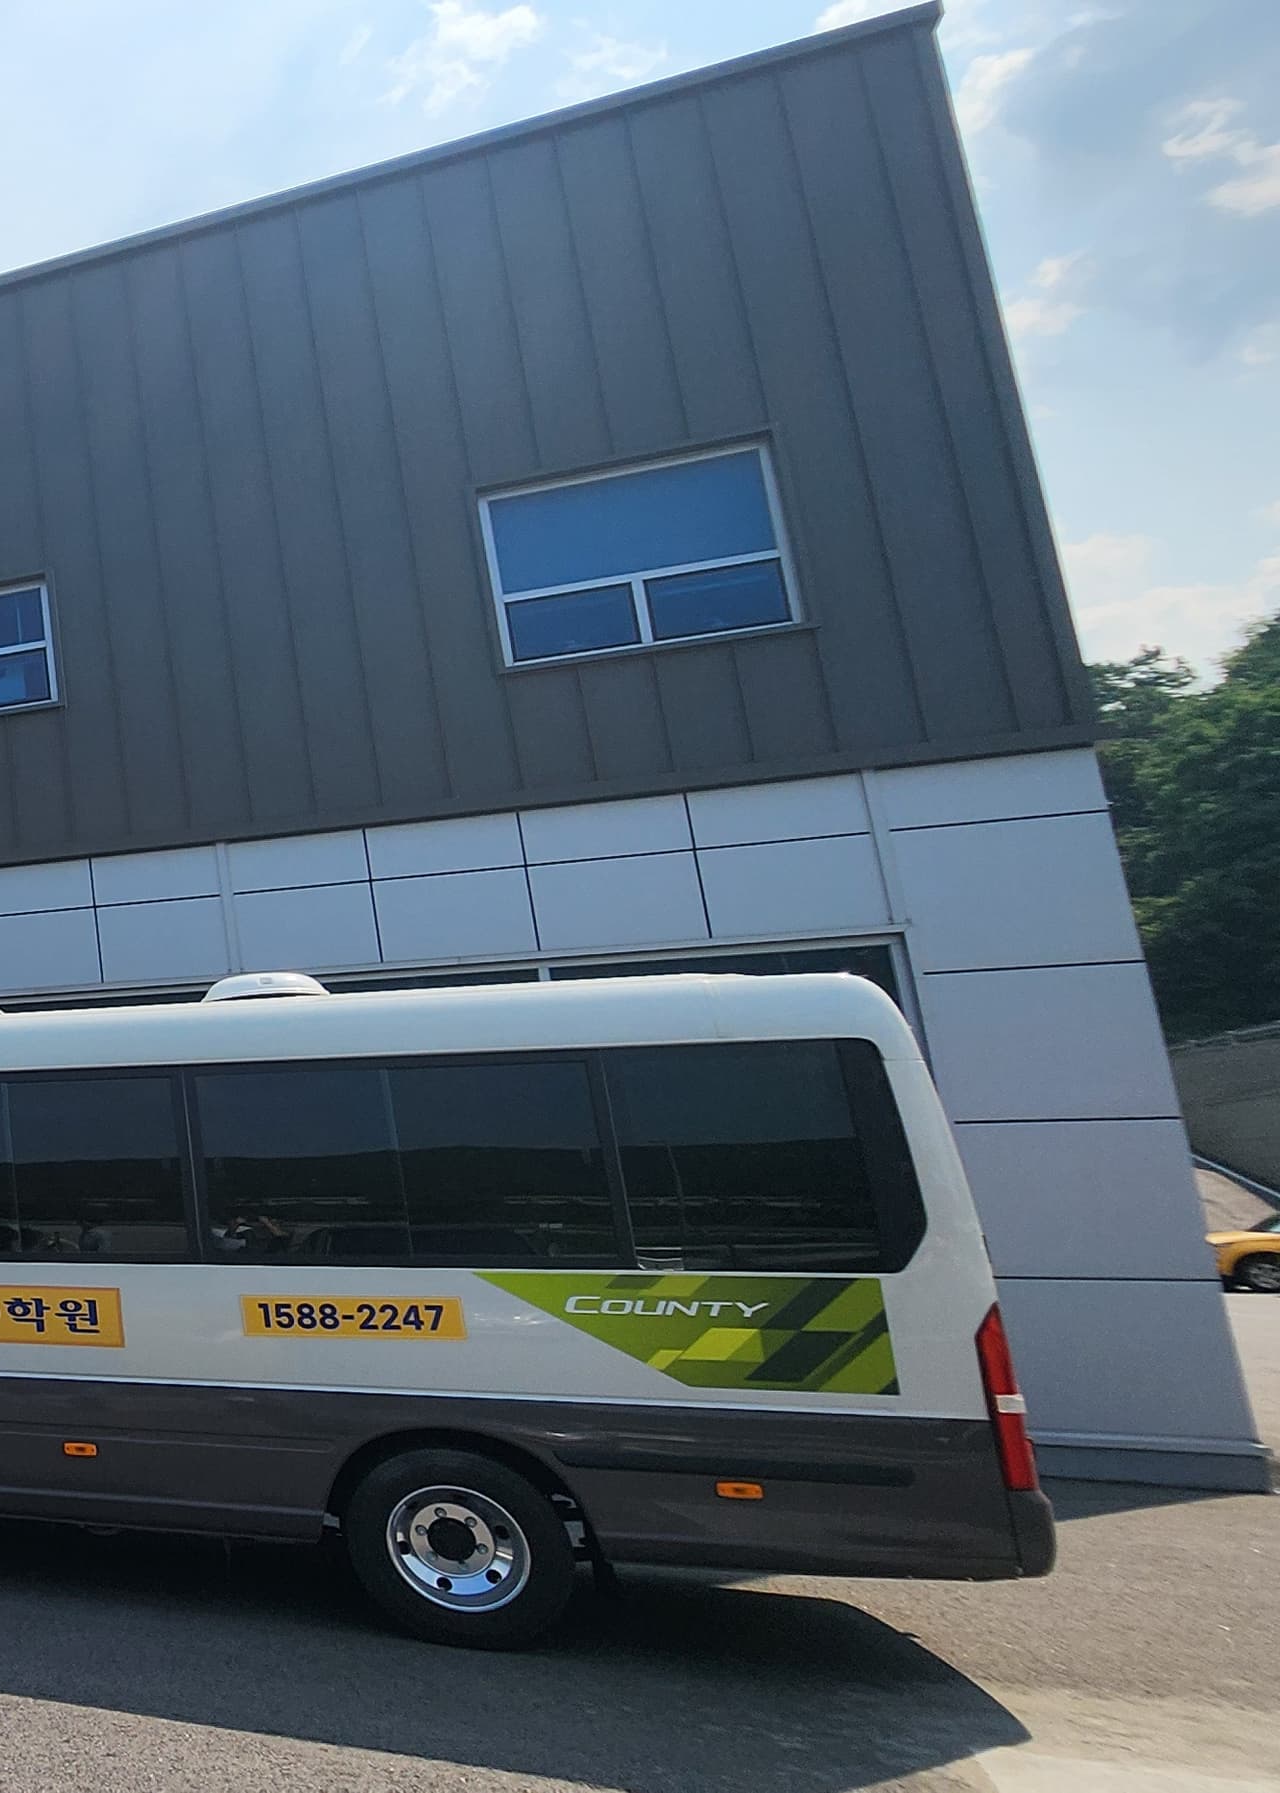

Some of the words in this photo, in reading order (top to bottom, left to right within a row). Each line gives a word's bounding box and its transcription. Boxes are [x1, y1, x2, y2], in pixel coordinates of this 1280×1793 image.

[5, 1297, 101, 1334] 학원
[257, 1302, 445, 1332] 1588-2247
[564, 1295, 770, 1319] COUNTY
